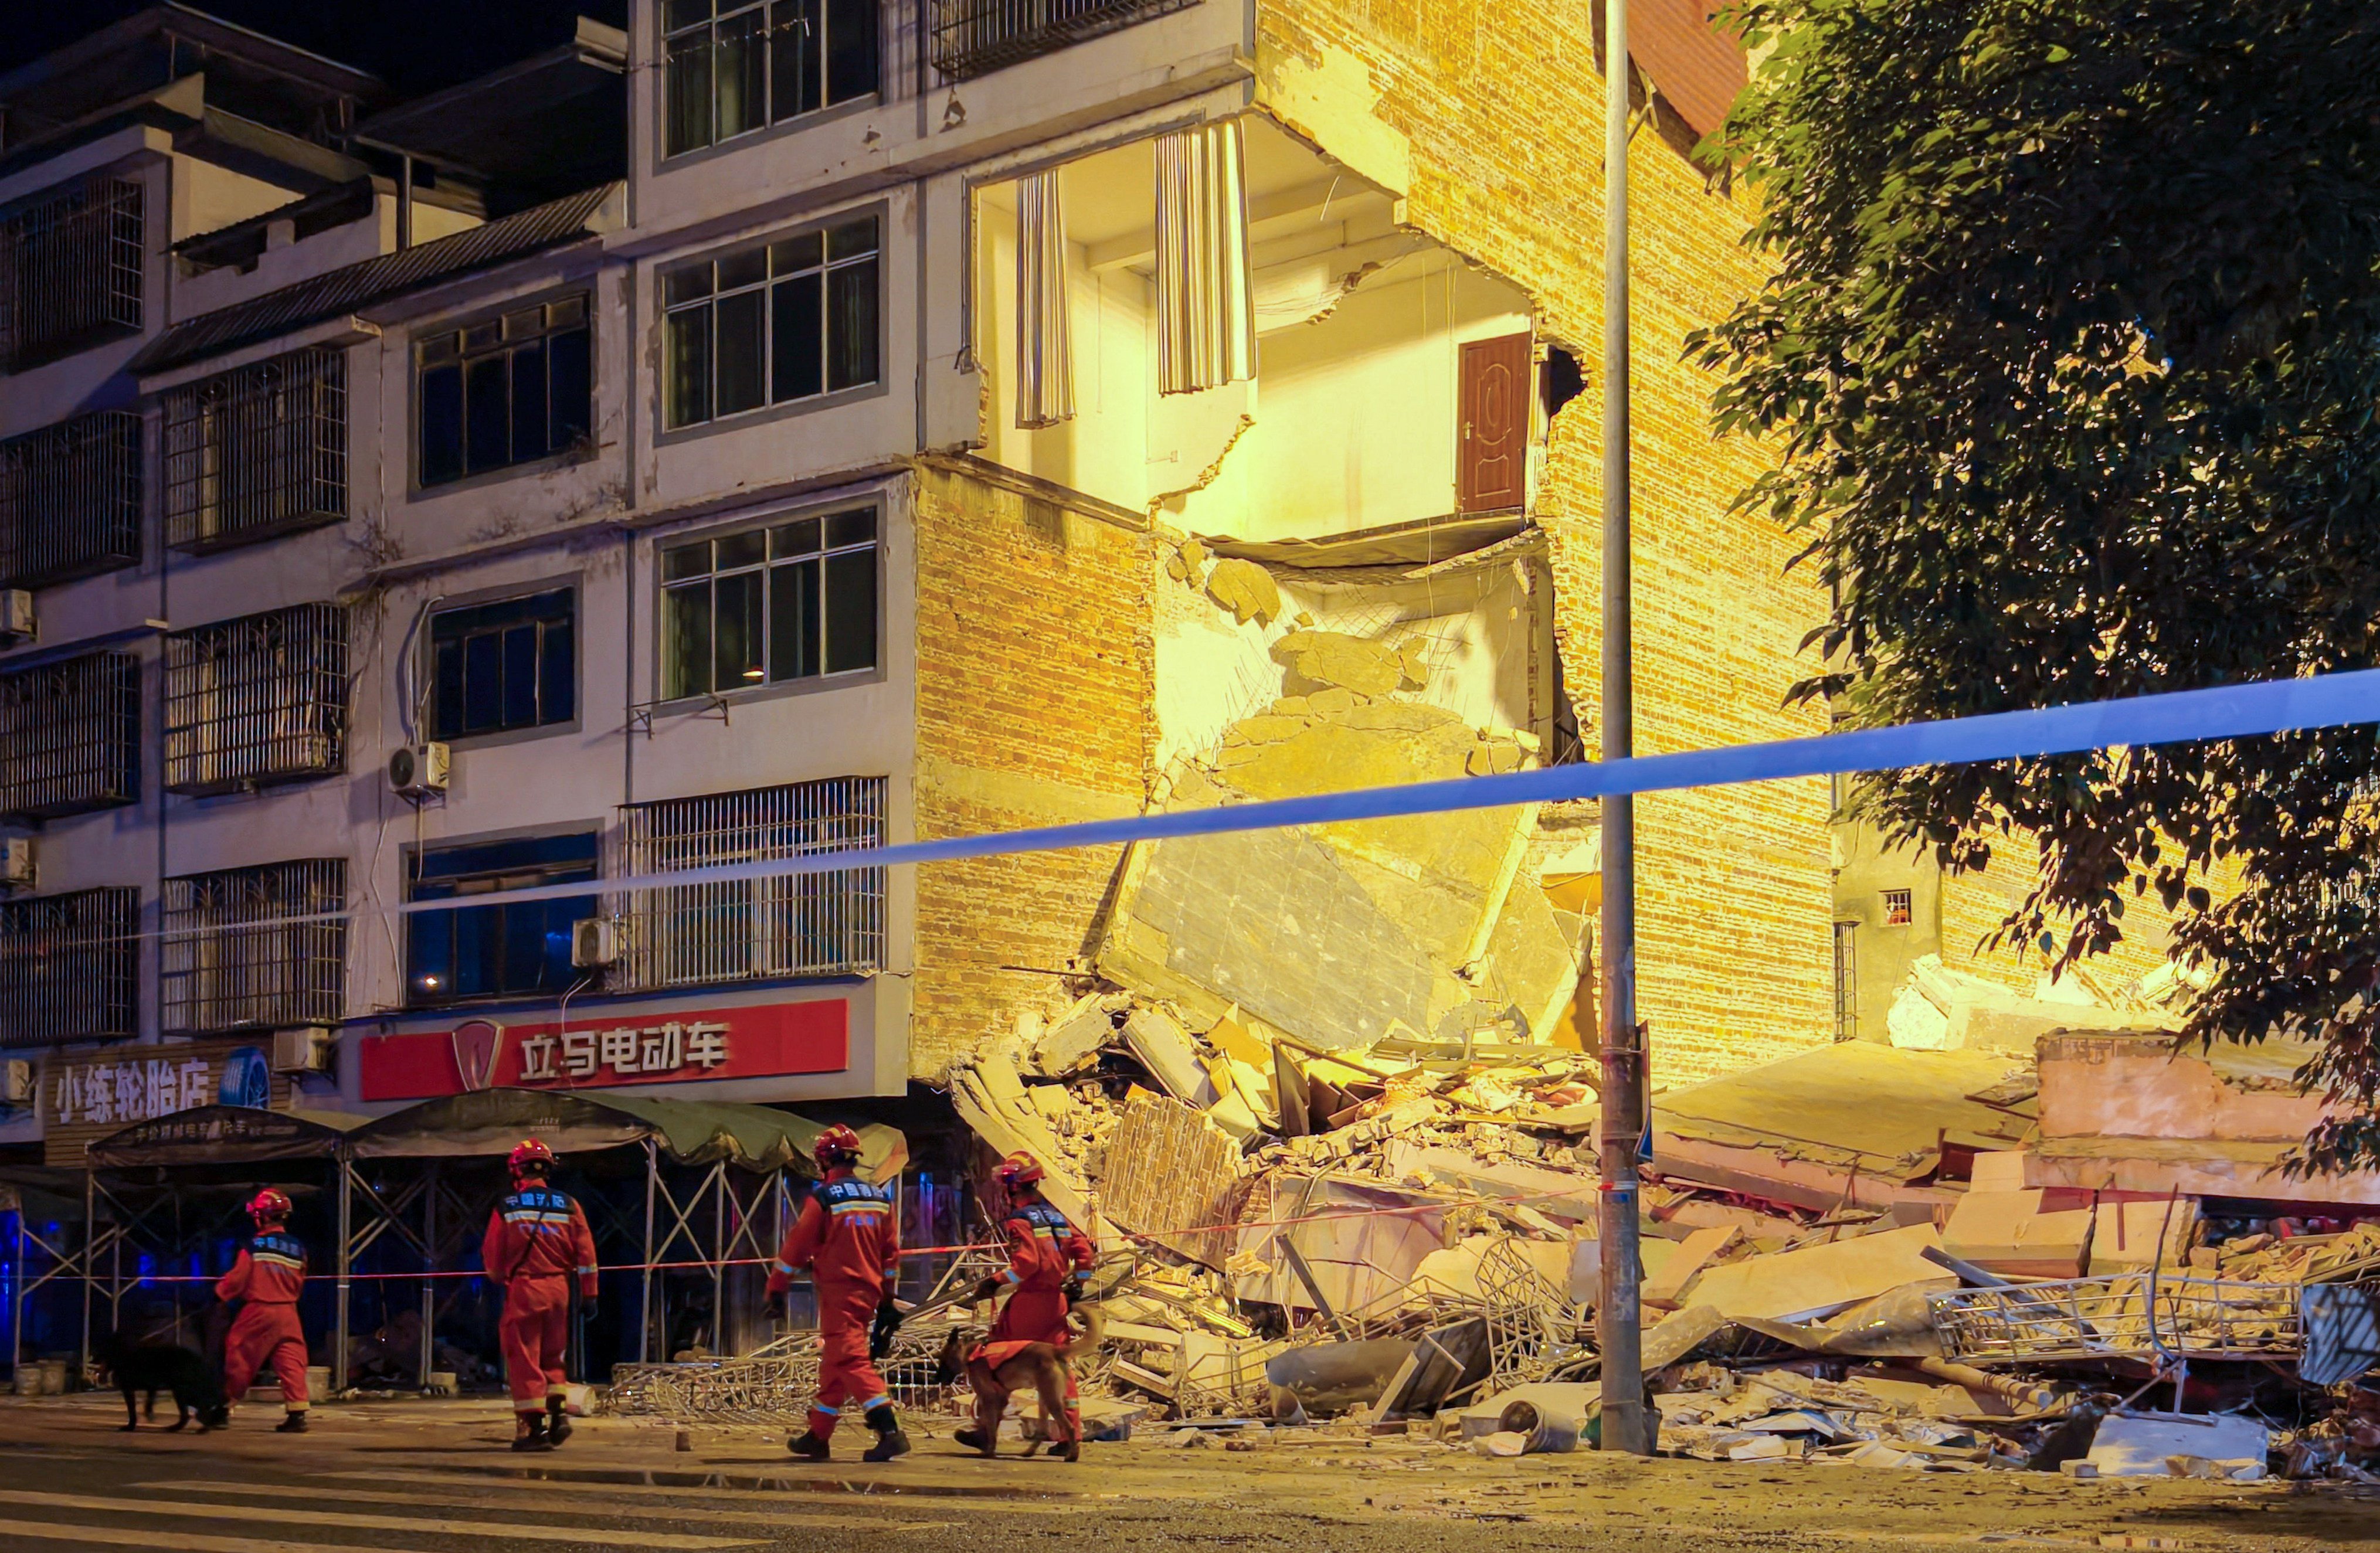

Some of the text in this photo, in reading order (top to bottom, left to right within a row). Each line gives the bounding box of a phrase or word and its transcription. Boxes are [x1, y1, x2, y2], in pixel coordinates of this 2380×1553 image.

[520, 1021, 729, 1080] 立马电动车
[56, 1056, 209, 1124] 小练轮胎店
